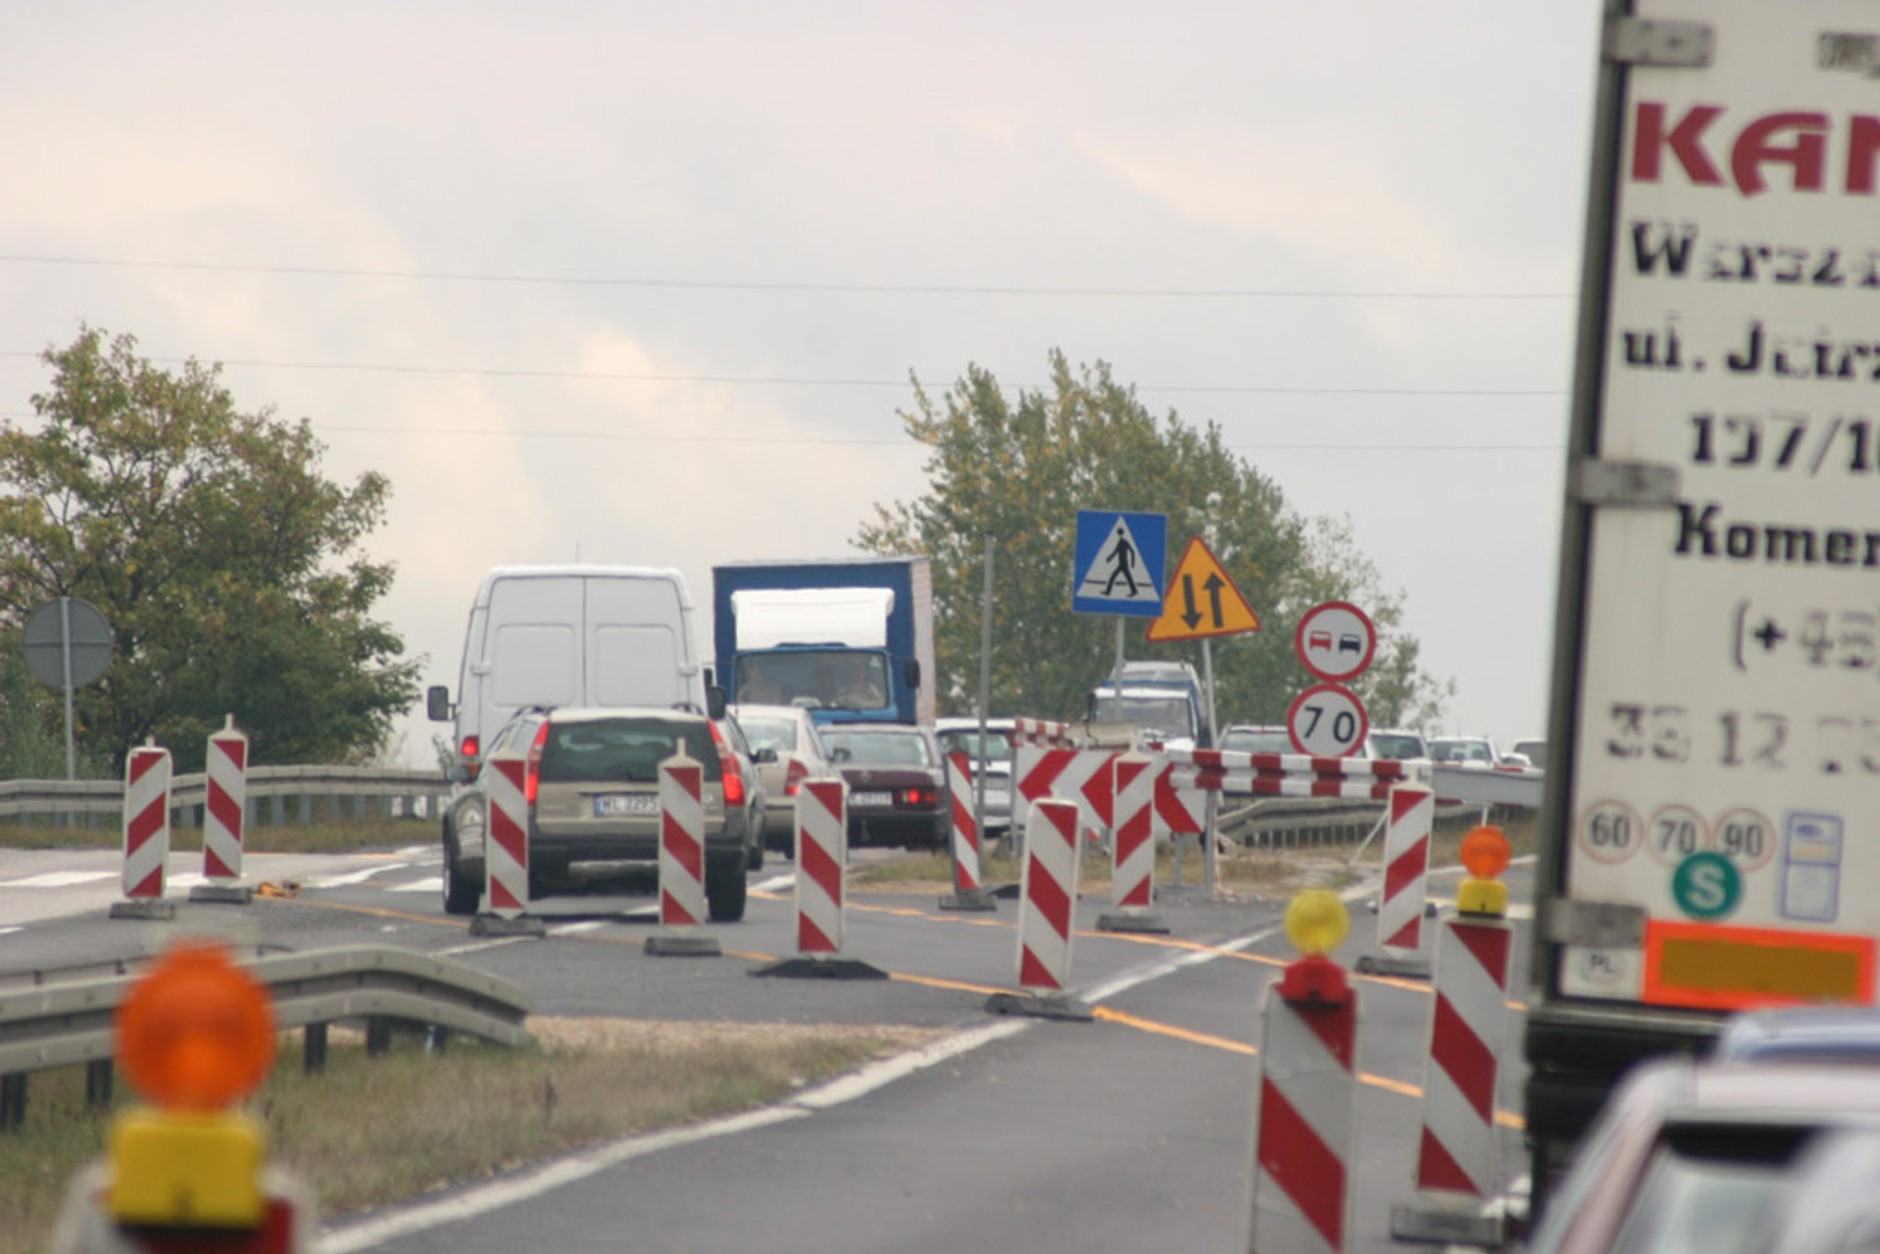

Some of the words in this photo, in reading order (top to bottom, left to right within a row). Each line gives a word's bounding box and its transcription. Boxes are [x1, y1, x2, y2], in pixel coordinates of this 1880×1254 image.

[1304, 706, 1355, 743] 70
[1590, 813, 1631, 848] 60
[1658, 819, 1697, 855] 70
[1724, 823, 1765, 858] 90
[1685, 862, 1727, 910] S
